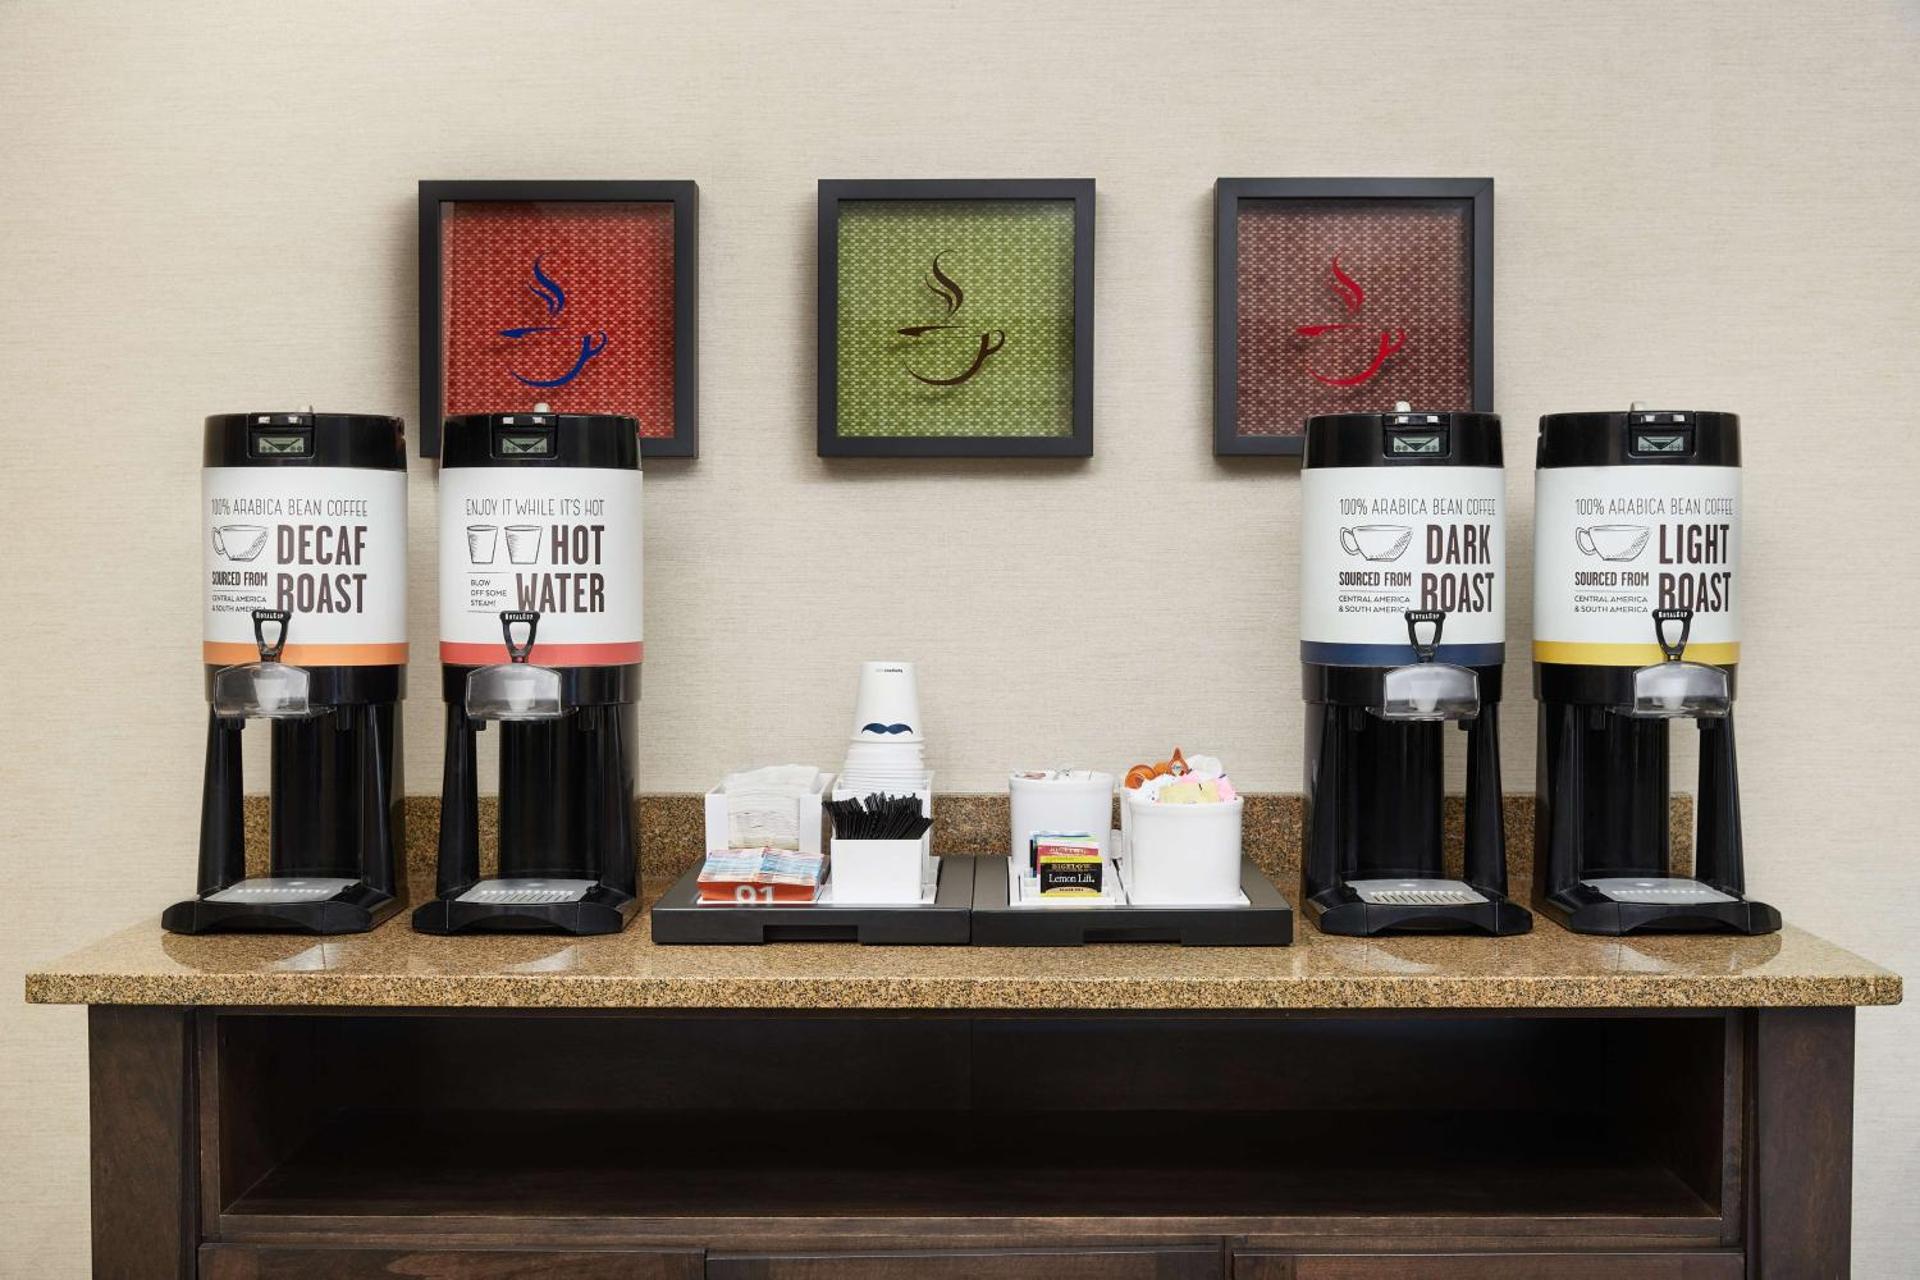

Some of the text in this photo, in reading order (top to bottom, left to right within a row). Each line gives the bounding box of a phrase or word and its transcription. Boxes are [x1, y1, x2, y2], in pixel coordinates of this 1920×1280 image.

[233, 498, 282, 516] ARABICA
[288, 499, 321, 516] BEAN
[327, 500, 368, 517] COFFEE
[466, 498, 605, 516] ENJOY IT WHILE IT'S HOT
[1340, 498, 1496, 516] 100% ARABICA BEAN COFFEE
[1576, 498, 1733, 516] 100% ARABICA BEAN COFFEE
[277, 524, 368, 565] DECAF
[551, 524, 605, 565] HOT
[1426, 524, 1491, 565] DARK
[1659, 524, 1730, 564] LIGHT
[212, 571, 268, 587] SOURCED FROM
[470, 579, 491, 587] BLOW
[1339, 571, 1412, 587] SOURCED FROM
[1575, 571, 1649, 587] SOURCED FROM
[236, 595, 266, 603] AMERICA
[277, 573, 367, 613] ROAST
[470, 589, 507, 597] OFF SOME
[515, 573, 605, 613] WATER
[1338, 595, 1410, 603] CENTRAL AMERICA
[1421, 572, 1495, 613] ROAST
[1574, 595, 1648, 603] CENTRAL AMERICA
[1659, 572, 1731, 612] ROAST
[470, 599, 496, 607] STEAM!
[1048, 873, 1076, 883] Lemon
